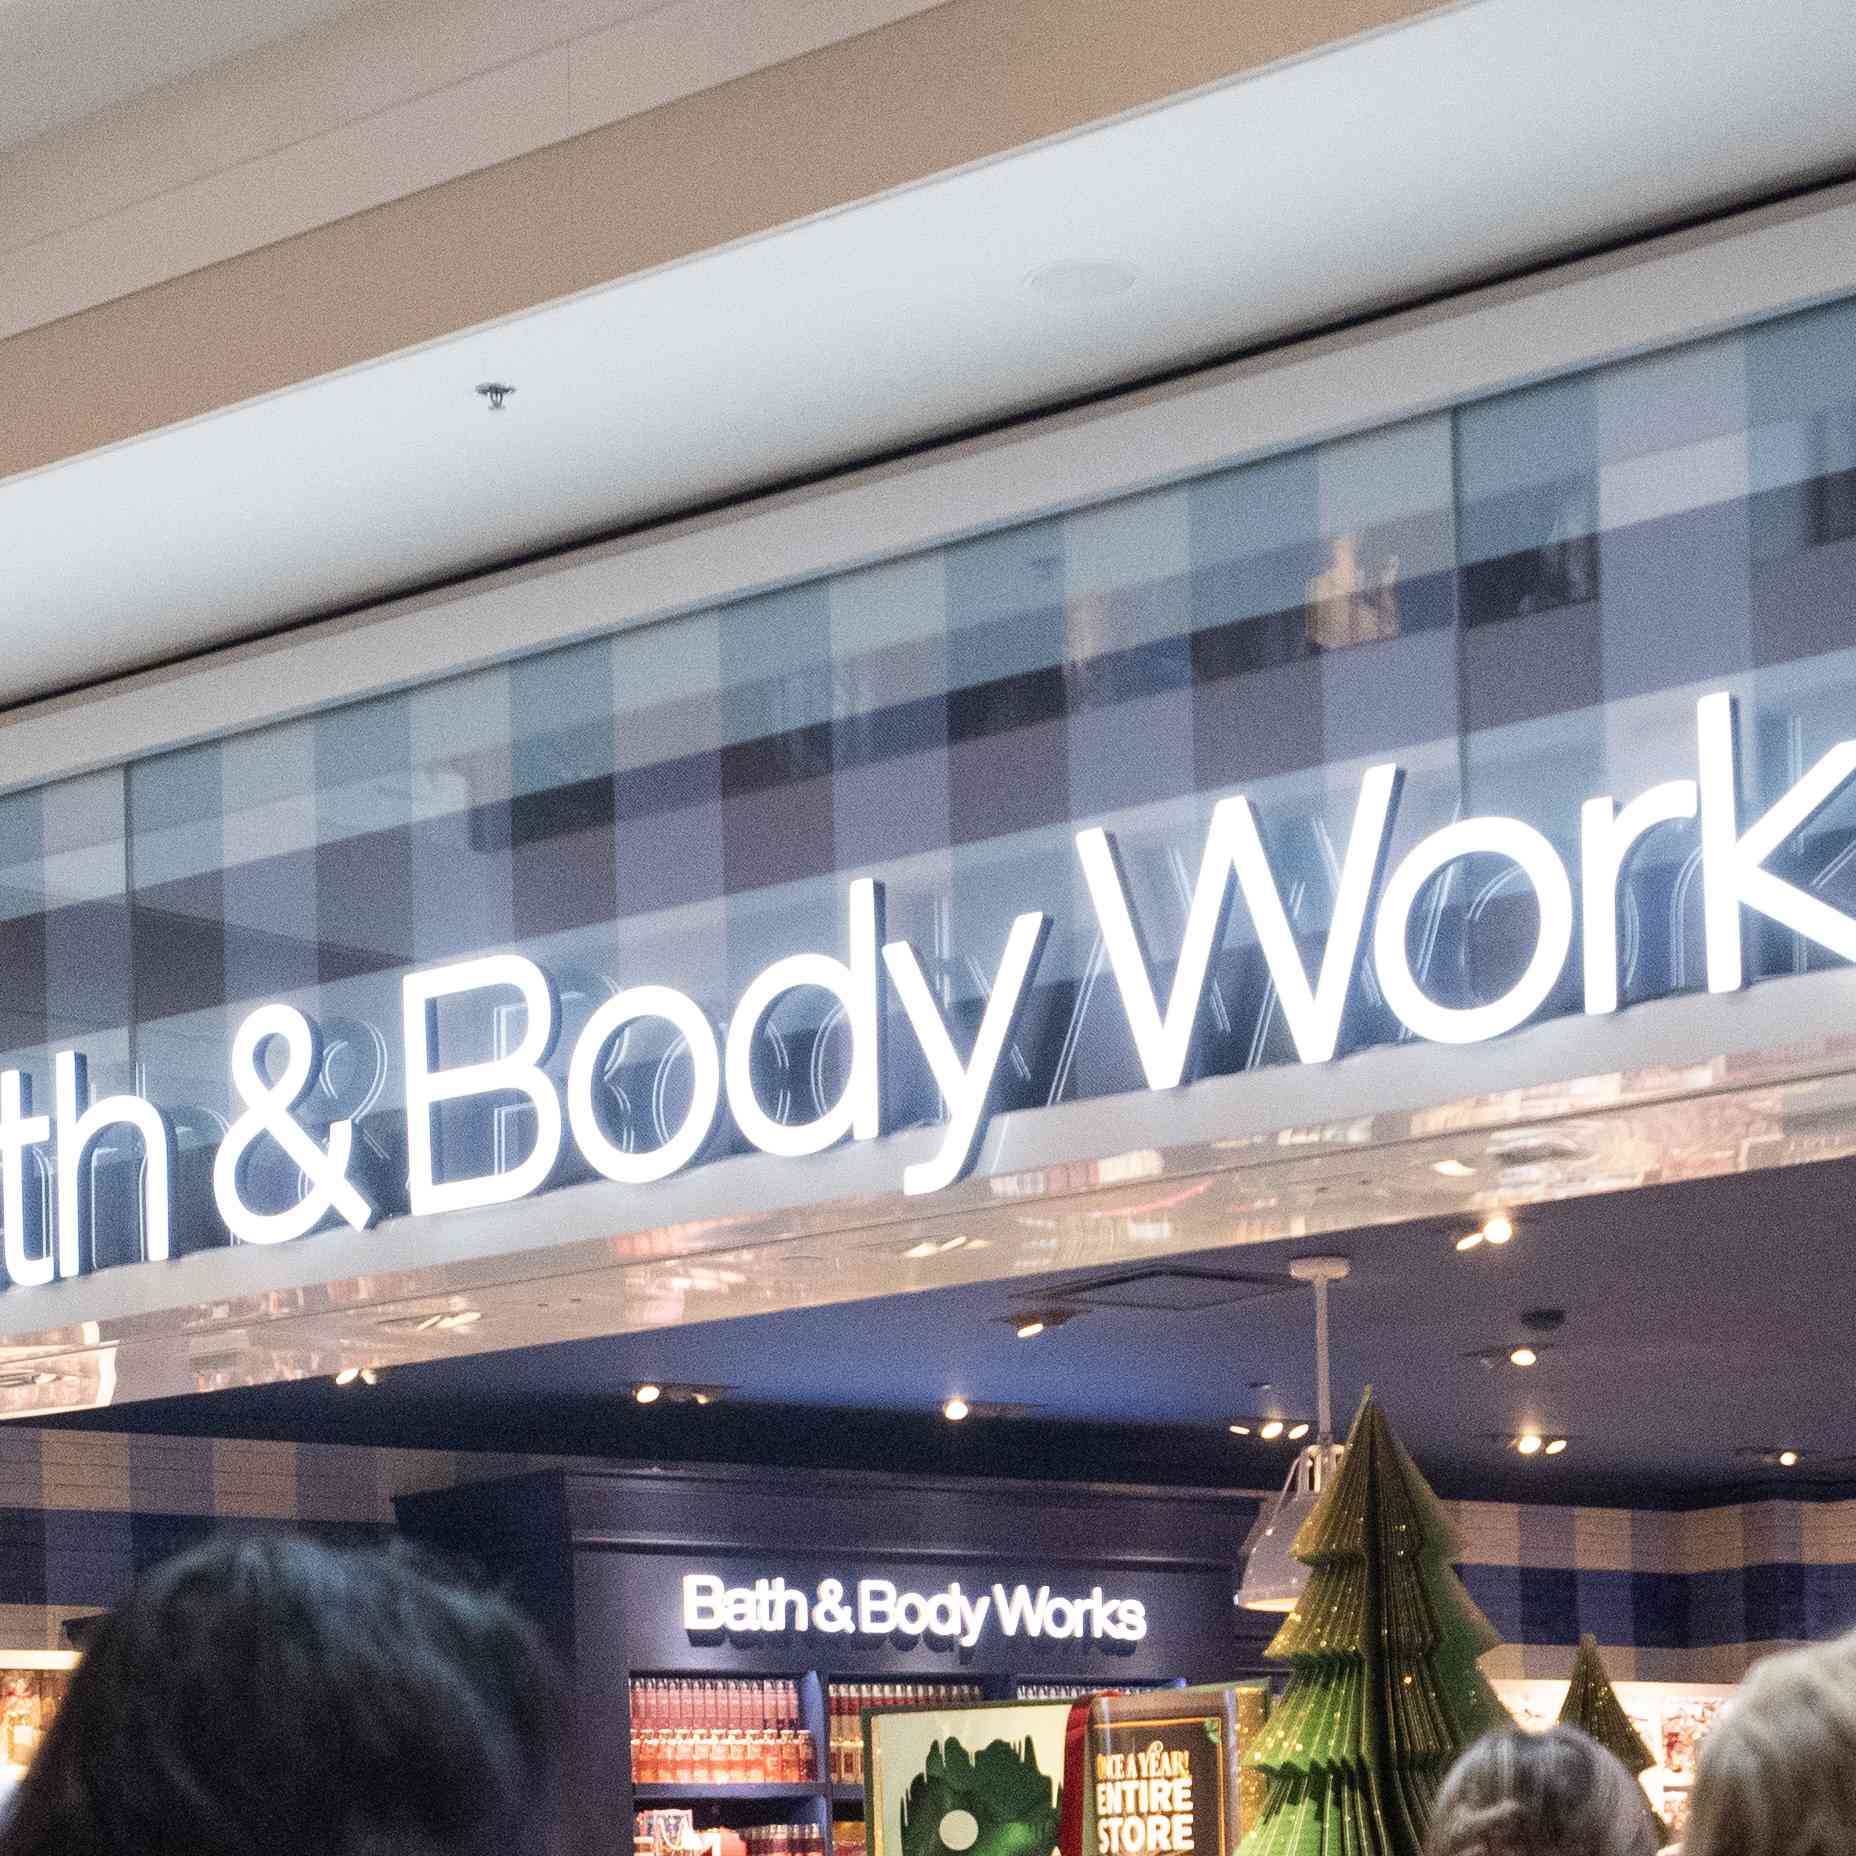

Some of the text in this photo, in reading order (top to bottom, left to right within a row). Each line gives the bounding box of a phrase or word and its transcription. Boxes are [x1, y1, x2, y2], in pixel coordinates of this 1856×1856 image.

[214, 1003, 371, 1246] &
[403, 878, 1044, 1197] Body
[682, 1574, 1147, 1647] Bath & Body Works
[1126, 1753, 1138, 1777] A
[1138, 1740, 1190, 1777] YEAR!
[1096, 1775, 1194, 1815] ENTIRE
[1097, 1814, 1195, 1855] STORE
